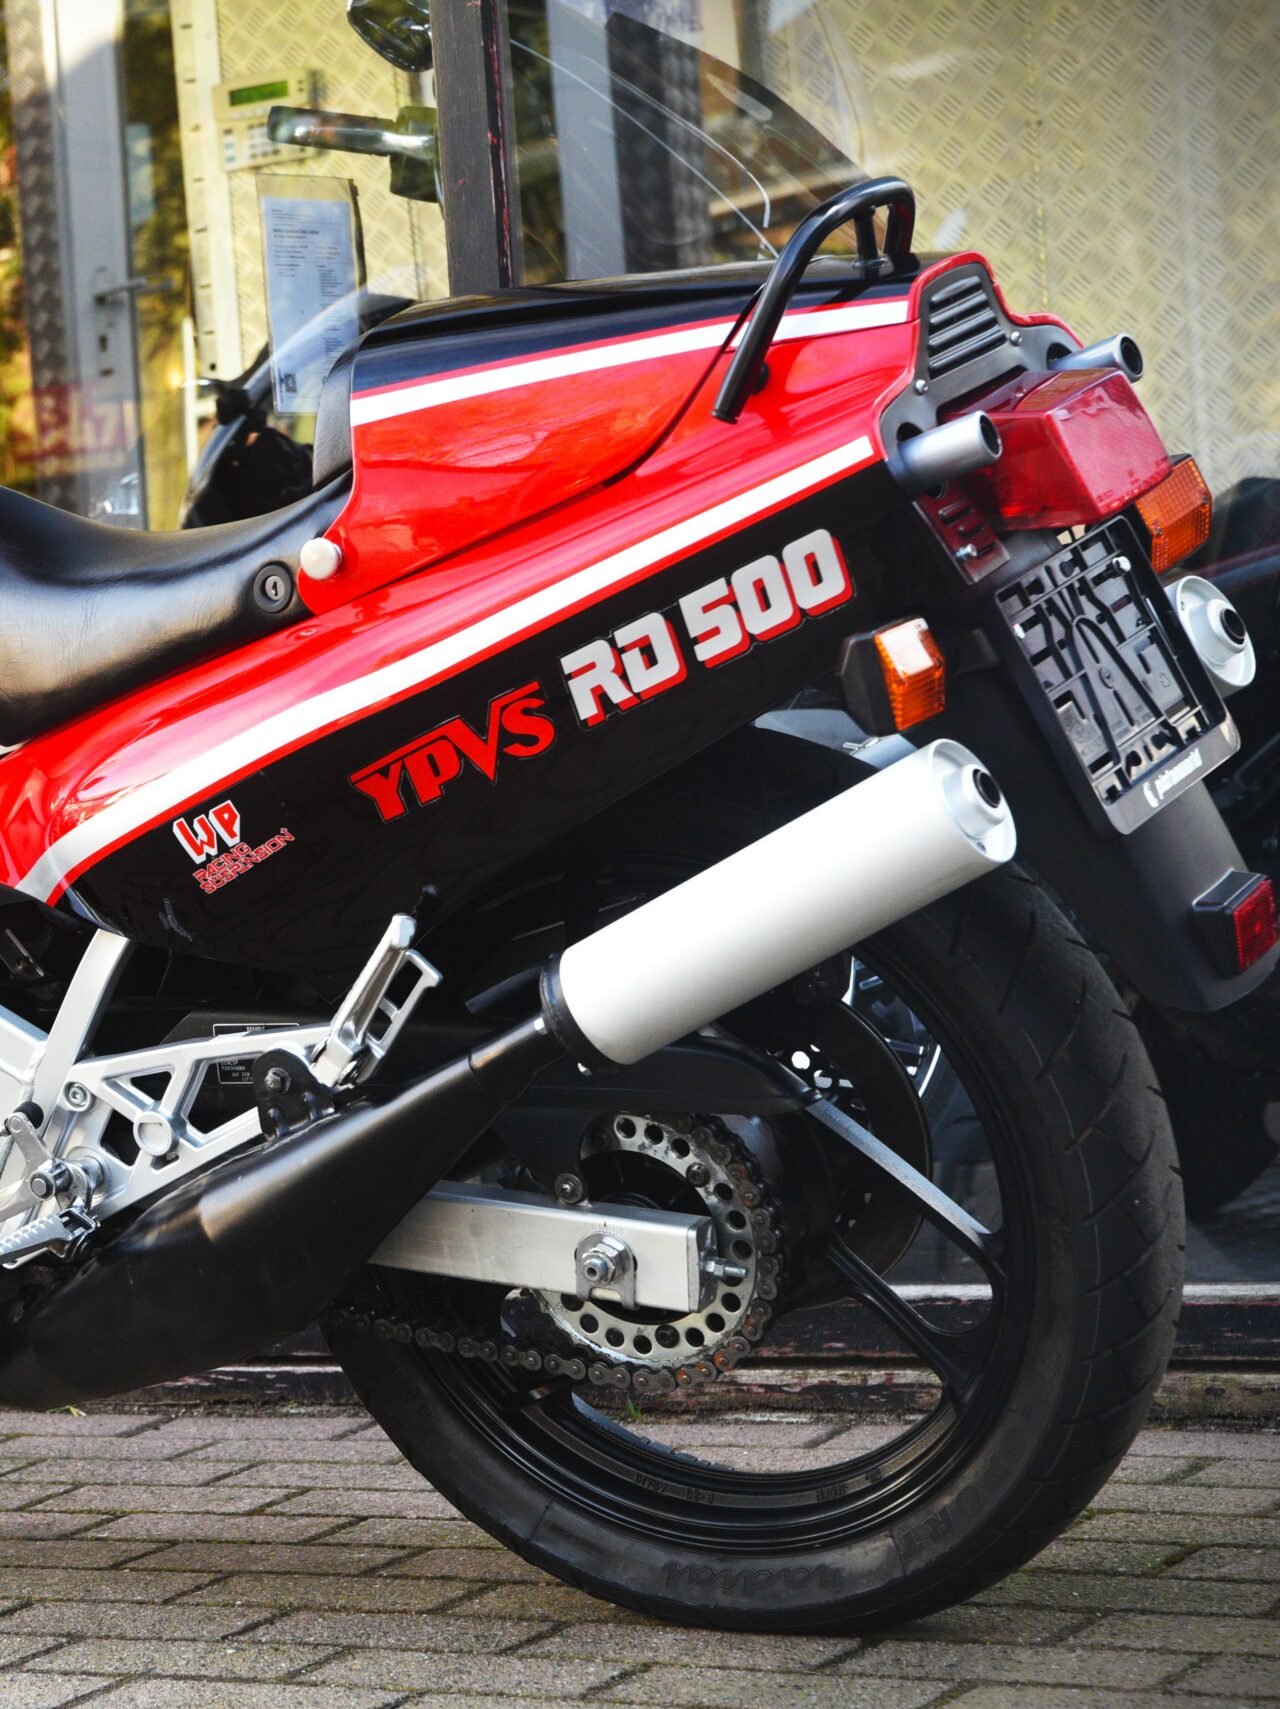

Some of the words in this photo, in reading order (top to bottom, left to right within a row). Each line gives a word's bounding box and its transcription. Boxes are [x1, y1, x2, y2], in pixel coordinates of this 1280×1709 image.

[347, 680, 557, 823] YPVS
[560, 611, 688, 729] RD
[678, 528, 855, 669] 500
[173, 800, 241, 864] WP
[192, 842, 252, 884] RACING
[200, 828, 295, 894] SUSPENSION
